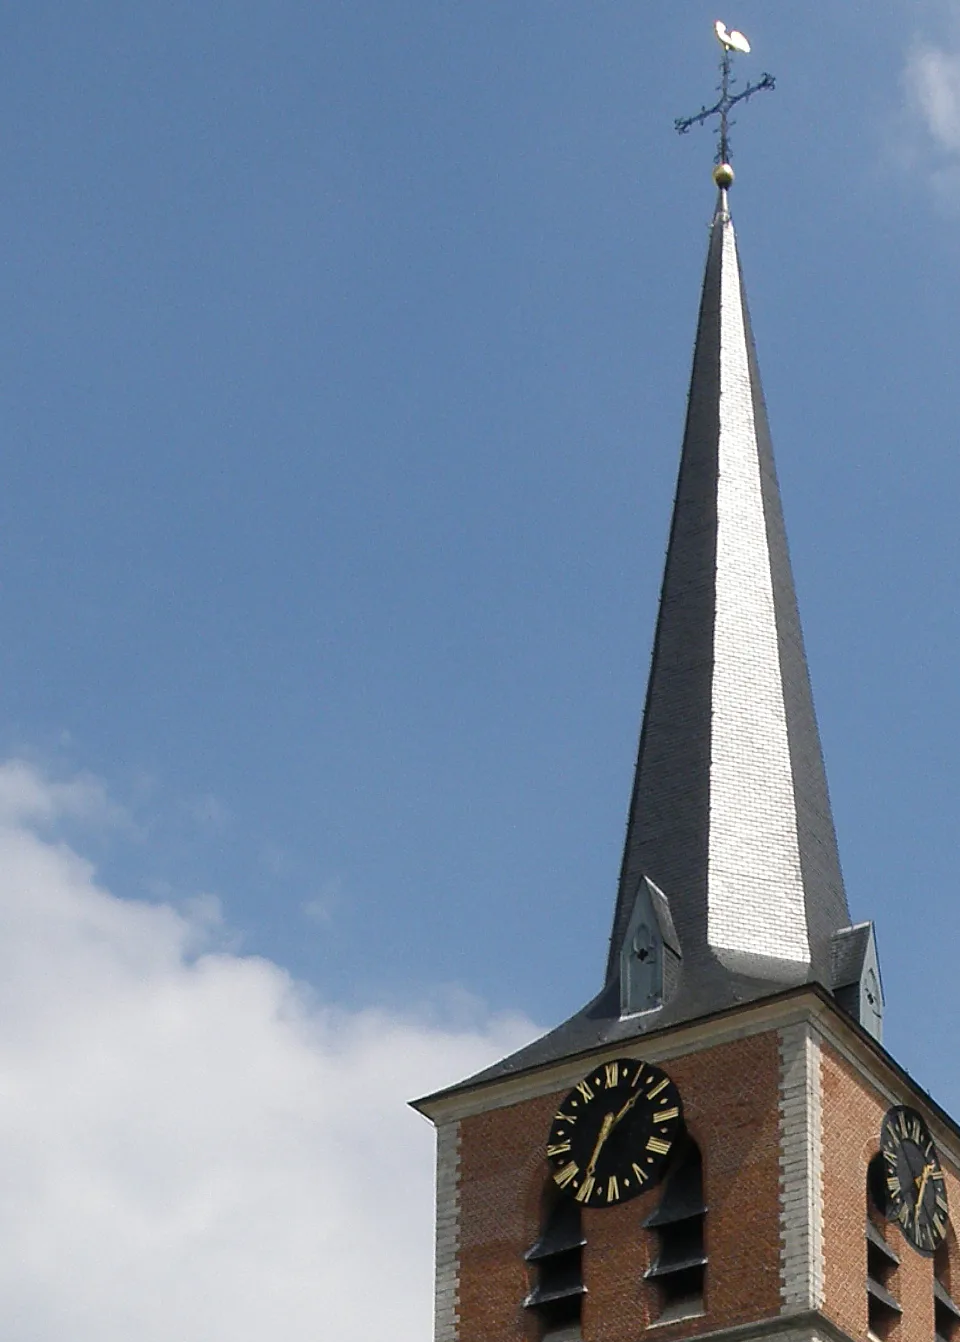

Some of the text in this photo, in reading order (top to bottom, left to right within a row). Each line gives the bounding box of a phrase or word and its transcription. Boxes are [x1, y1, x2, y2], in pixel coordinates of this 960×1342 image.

[605, 1062, 618, 1089] XII
[631, 1062, 645, 1087] I
[576, 1080, 594, 1103] XI
[647, 1078, 670, 1100] II
[554, 1110, 577, 1124] X
[653, 1107, 679, 1123] III
[547, 1139, 571, 1156] IX
[645, 1136, 672, 1155] IIII
[553, 1160, 579, 1189] VIII
[632, 1163, 648, 1184] V
[575, 1176, 595, 1203] VII
[607, 1175, 619, 1202] VI
